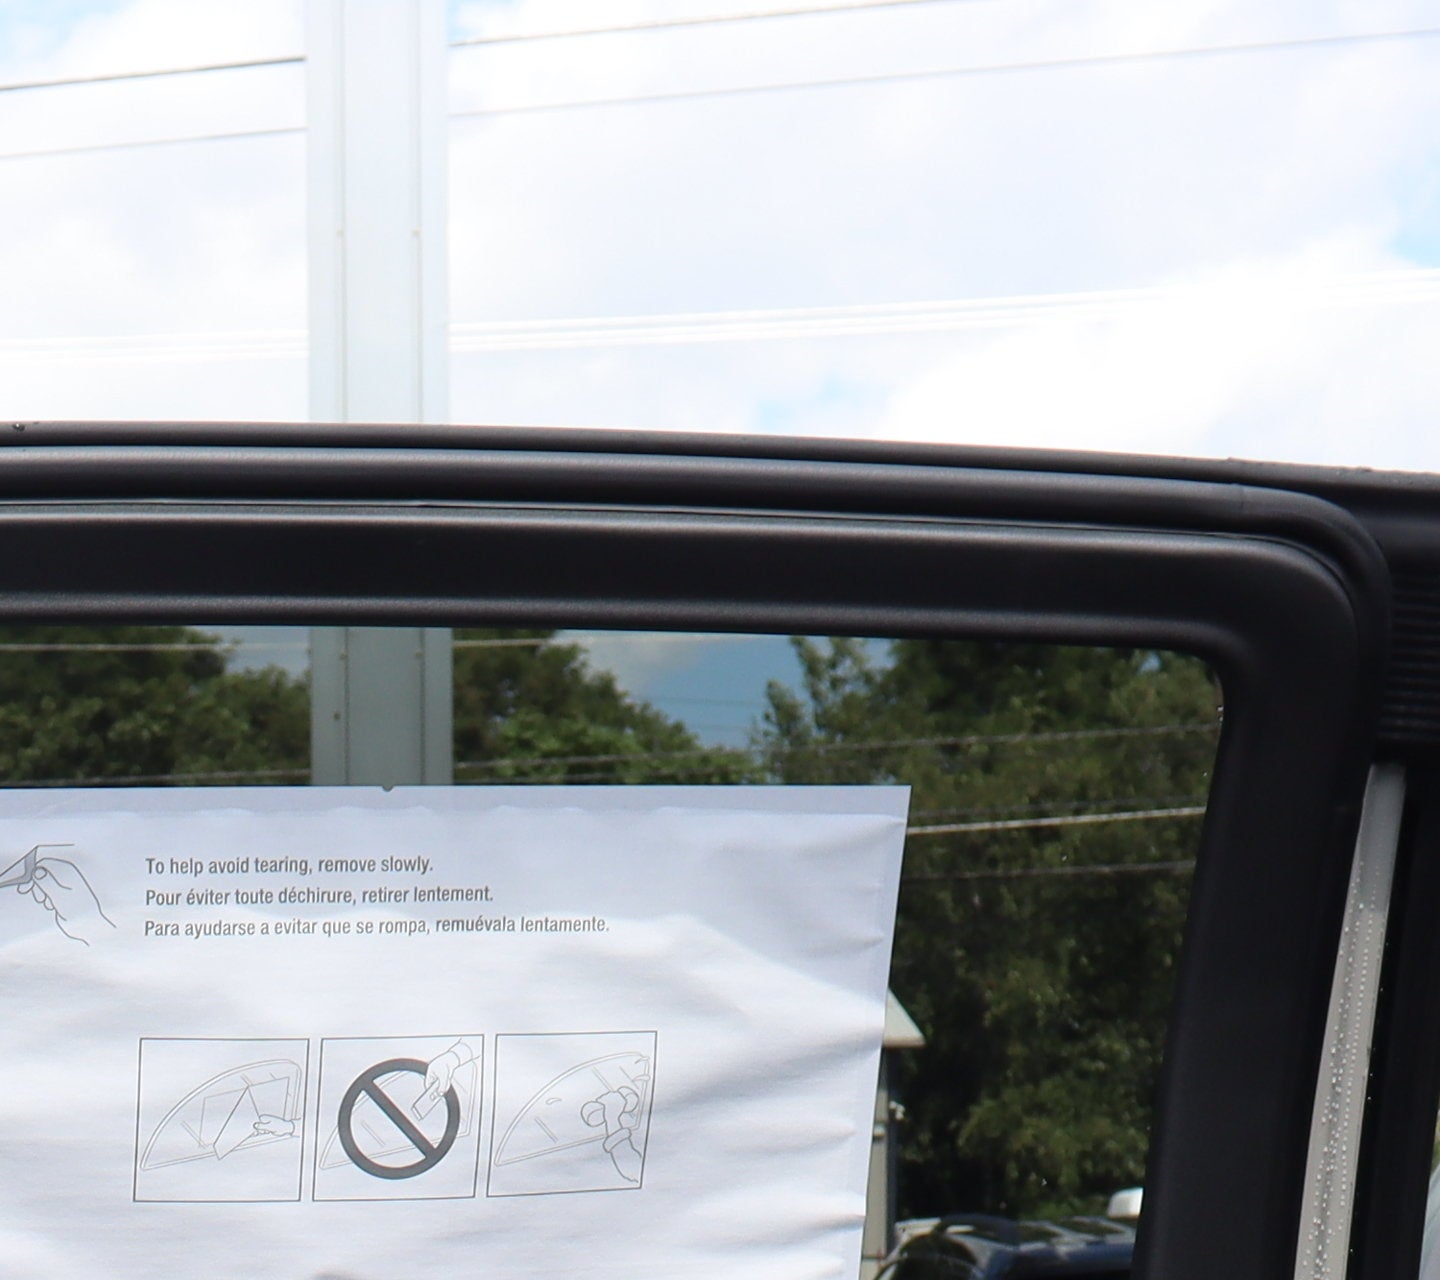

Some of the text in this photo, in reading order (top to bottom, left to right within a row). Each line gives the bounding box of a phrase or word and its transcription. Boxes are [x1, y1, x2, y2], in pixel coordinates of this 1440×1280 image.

[145, 855, 433, 877] To help avoid tearing, remove slowly.
[145, 886, 493, 906] Pour éviter toute déchirure, retirer lentement.
[145, 915, 609, 940] Para ayudarse a evitar que se rompa, remuévala lentamente.
